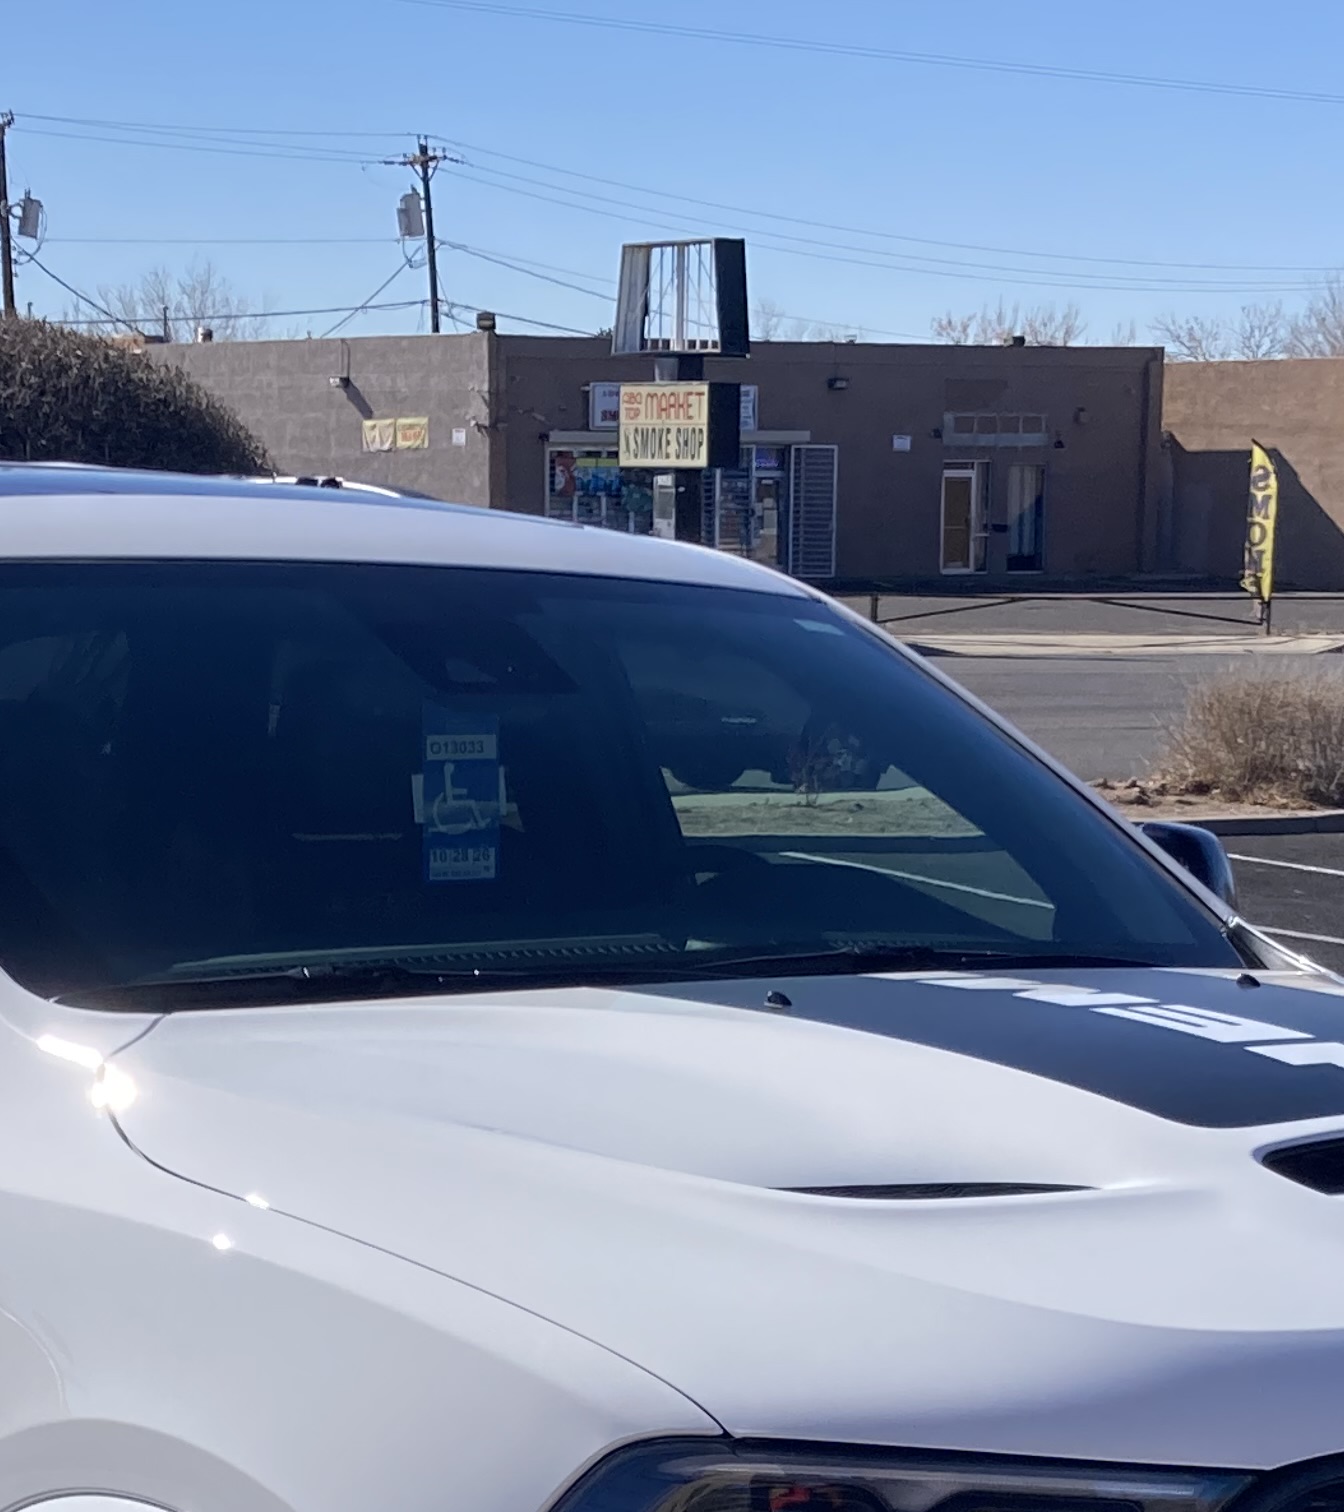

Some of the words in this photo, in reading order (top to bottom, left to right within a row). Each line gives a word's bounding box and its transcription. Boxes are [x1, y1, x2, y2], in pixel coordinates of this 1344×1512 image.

[624, 407, 641, 421] TOP
[644, 391, 706, 421] MARKET
[633, 427, 672, 460] SMOKE
[675, 427, 704, 460] SHOP
